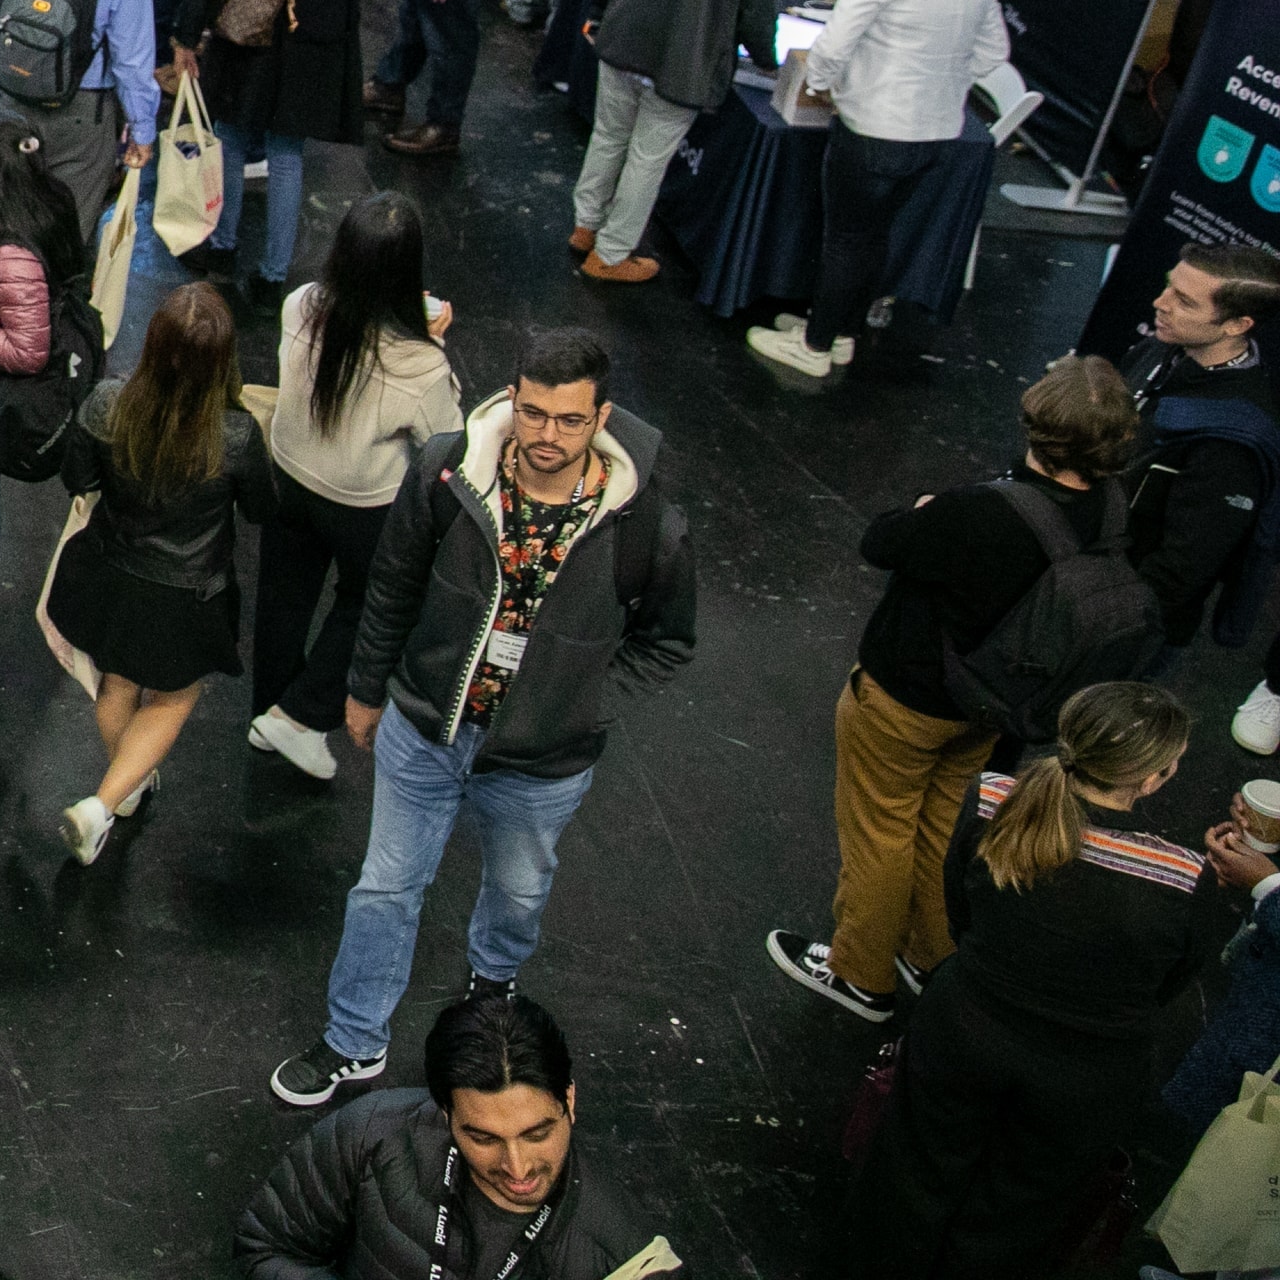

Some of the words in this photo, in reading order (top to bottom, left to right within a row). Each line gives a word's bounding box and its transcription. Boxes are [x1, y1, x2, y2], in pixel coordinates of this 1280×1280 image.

[444, 1153, 455, 1186] Lucid
[435, 1212, 446, 1246] Lucid
[530, 1205, 551, 1233] Lucid
[497, 1252, 519, 1280] Lucid
